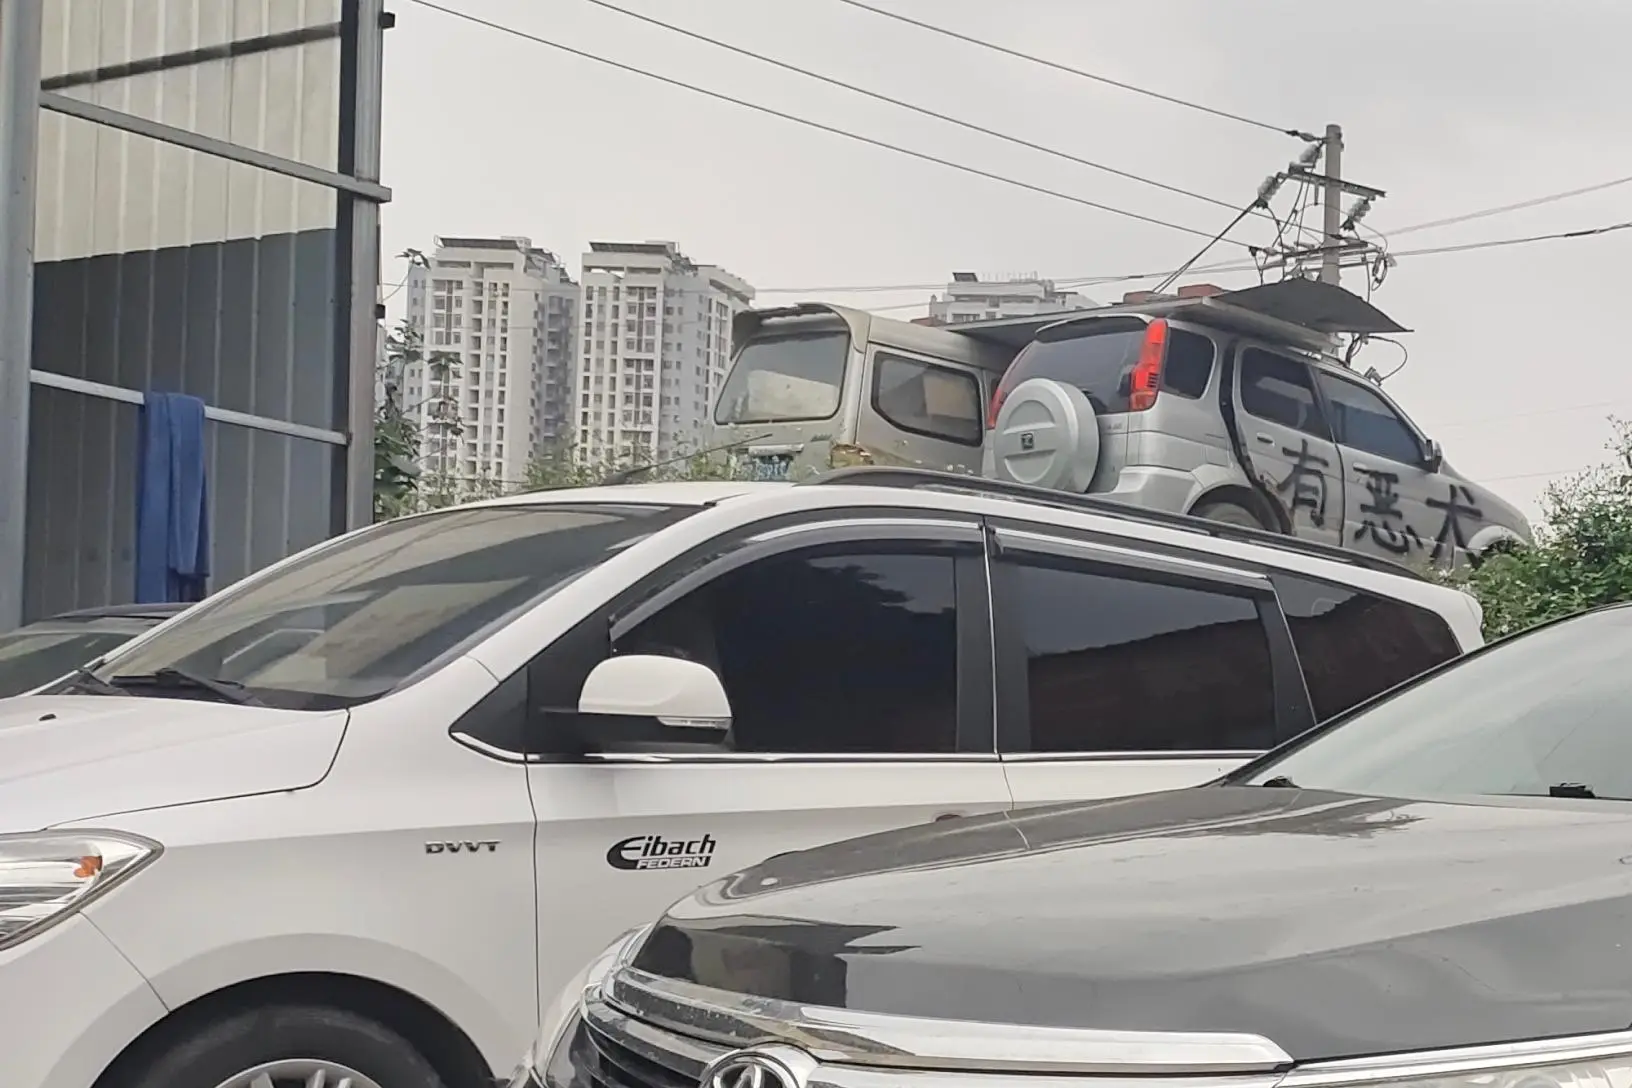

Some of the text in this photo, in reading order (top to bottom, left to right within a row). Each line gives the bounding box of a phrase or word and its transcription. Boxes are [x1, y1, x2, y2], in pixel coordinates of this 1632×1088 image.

[1277, 438, 1483, 570] 有恶犬
[424, 840, 502, 855] DVVT
[606, 833, 717, 870] Eibach
[636, 856, 709, 870] FEDERN
